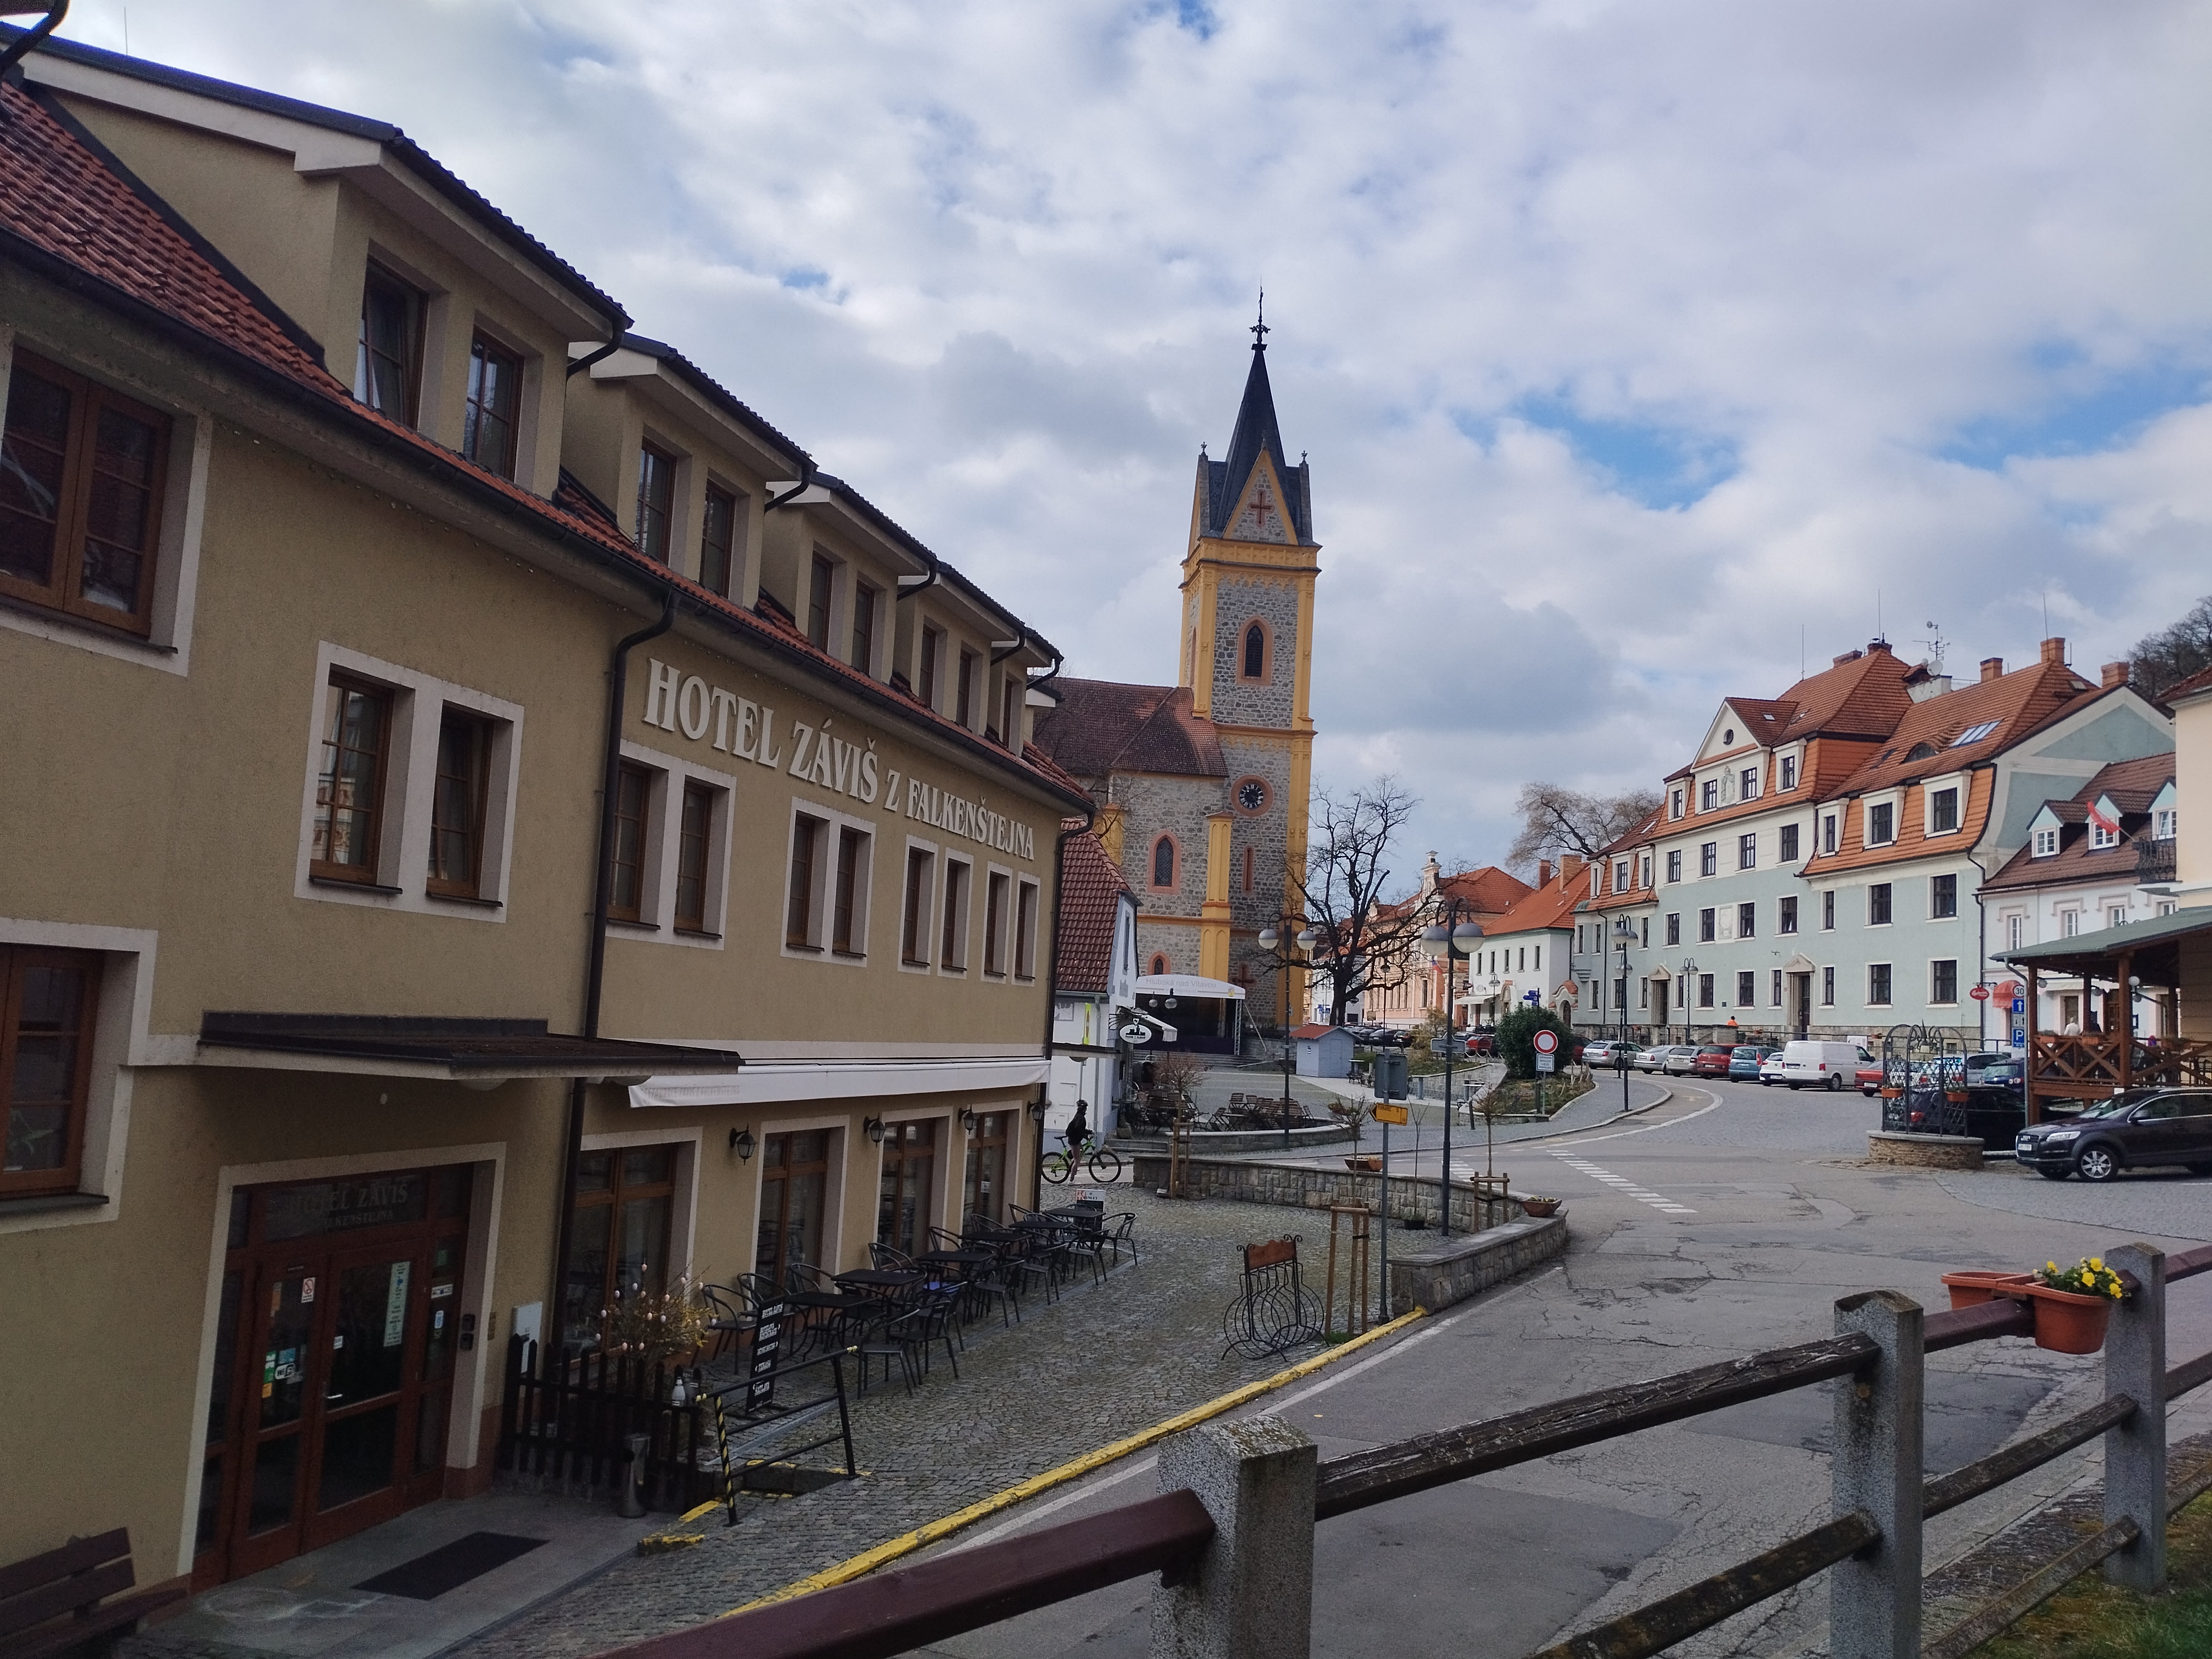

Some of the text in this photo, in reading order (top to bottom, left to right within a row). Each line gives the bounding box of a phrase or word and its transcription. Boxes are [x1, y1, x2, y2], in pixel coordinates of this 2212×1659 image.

[643, 658, 1035, 860] HOTEL ZÁVIŠ Z FALKENŠTEJNA
[1146, 978, 1173, 986] Hluboká
[2016, 1030, 2023, 1041] P
